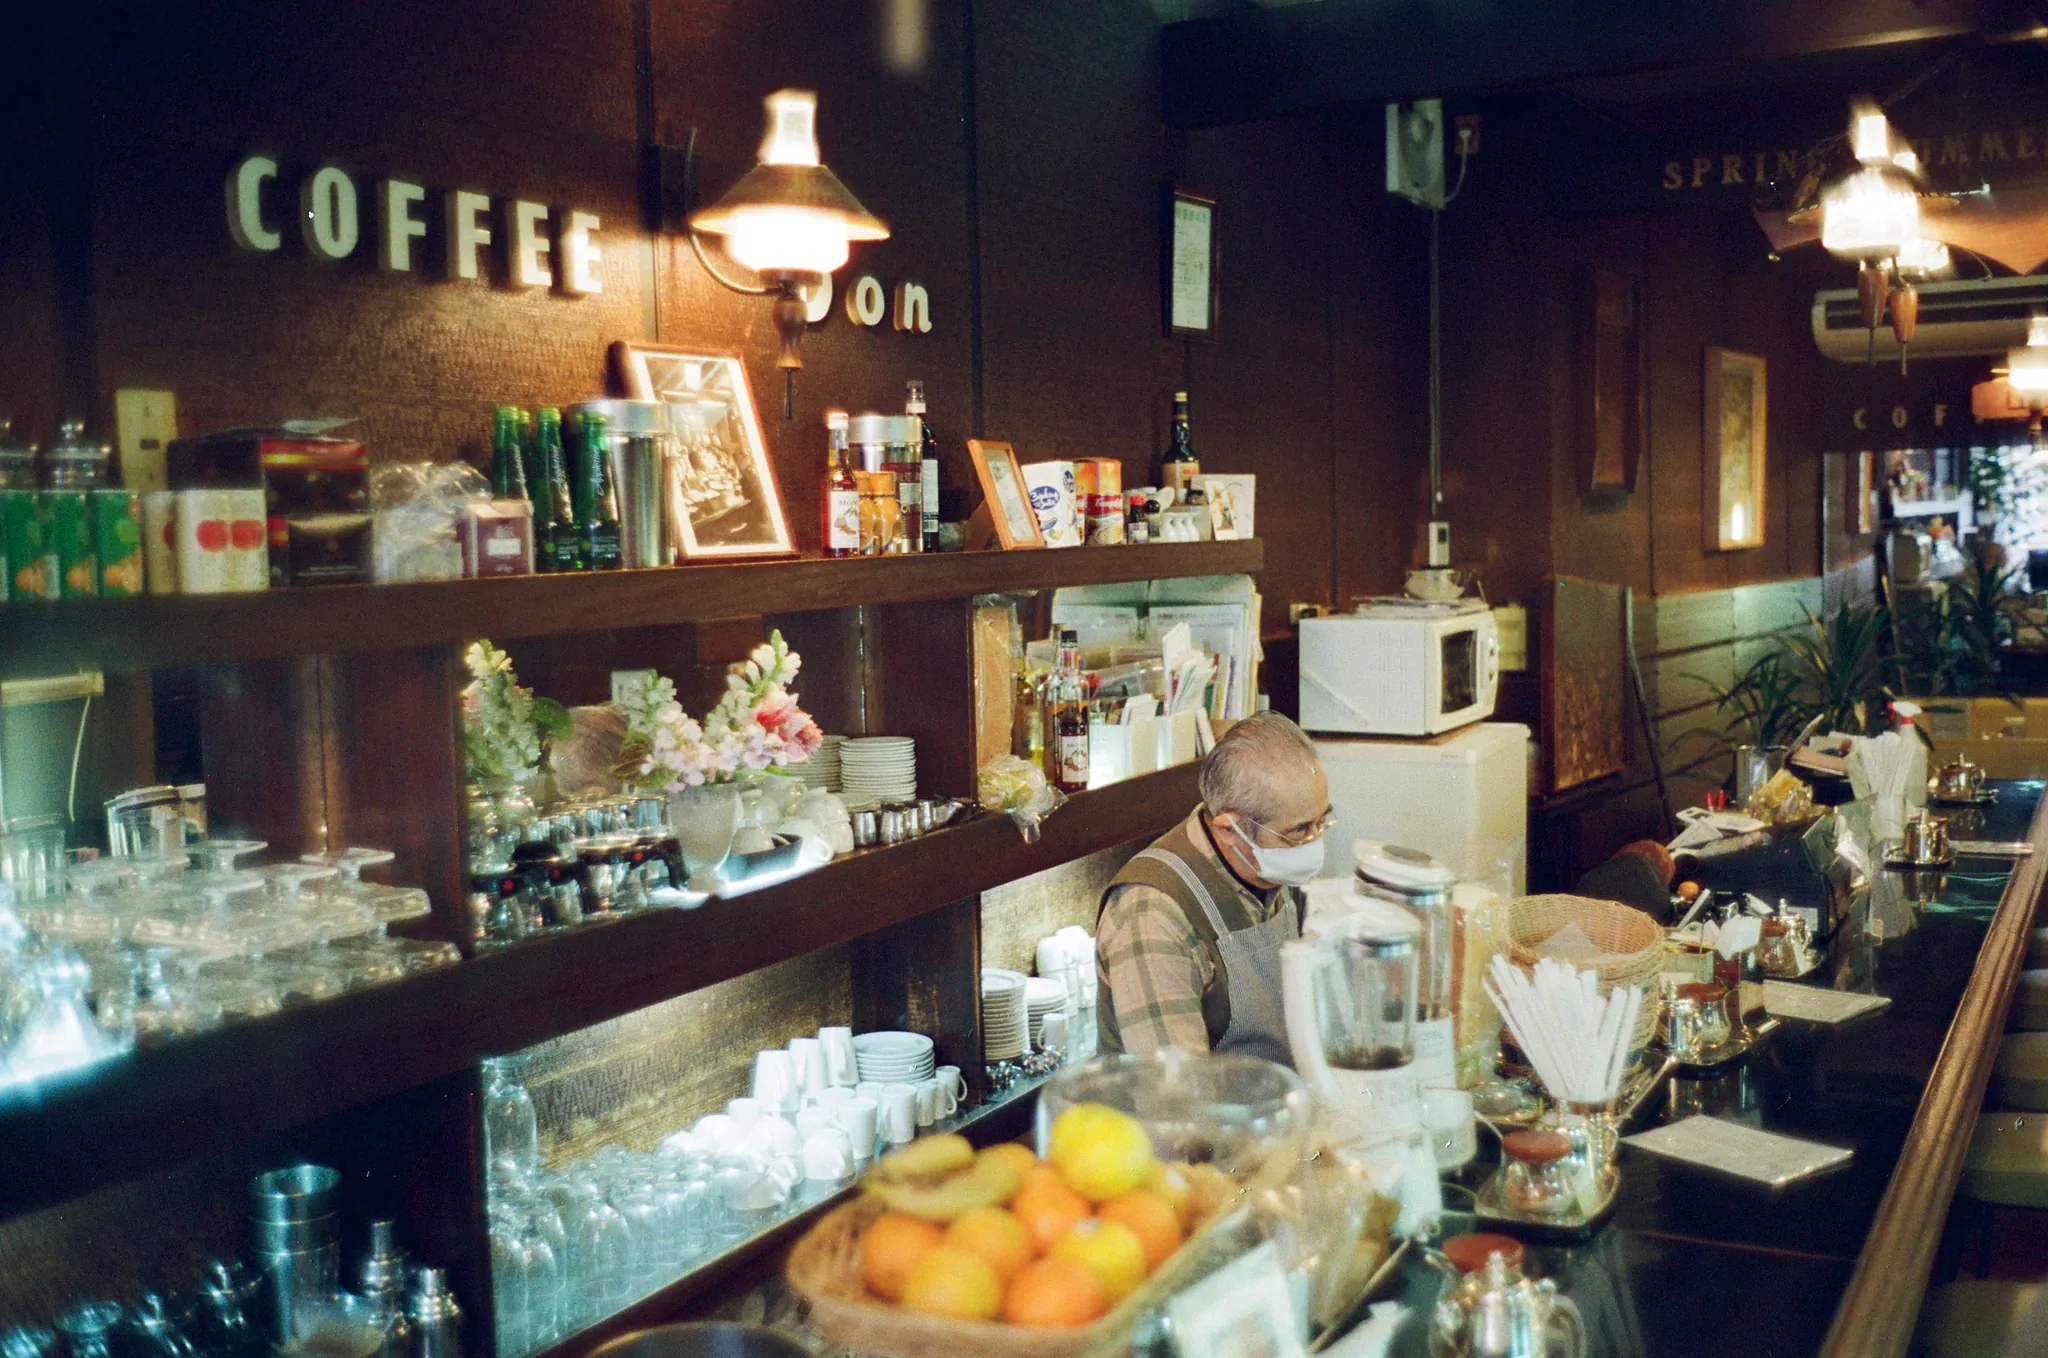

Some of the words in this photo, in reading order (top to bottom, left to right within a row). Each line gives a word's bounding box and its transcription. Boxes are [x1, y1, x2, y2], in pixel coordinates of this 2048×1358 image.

[1909, 127, 2048, 167] UMME
[226, 156, 602, 293] COFFEE
[1853, 403, 1984, 430] COF
